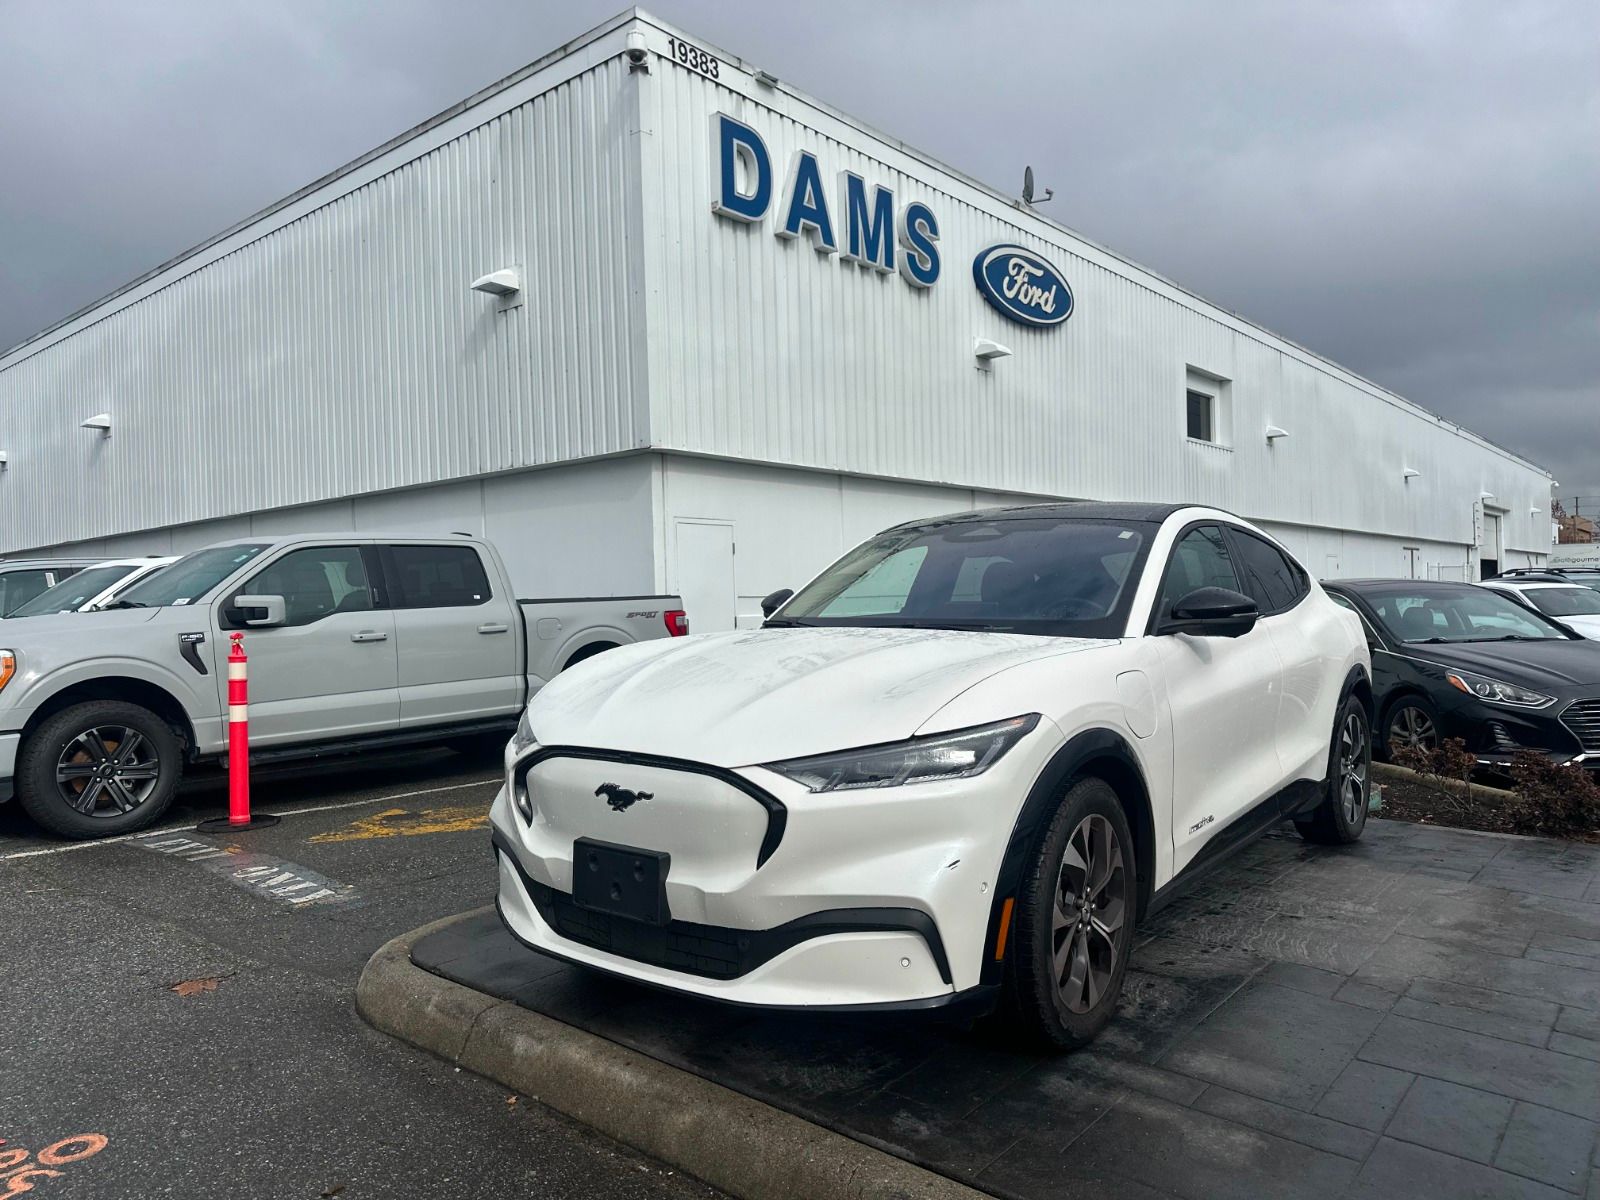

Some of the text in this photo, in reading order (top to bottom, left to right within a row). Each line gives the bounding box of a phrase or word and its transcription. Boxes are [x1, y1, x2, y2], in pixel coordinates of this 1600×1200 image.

[668, 38, 719, 79] 19383
[711, 111, 941, 289] DAMS
[1003, 257, 1057, 314] Ford
